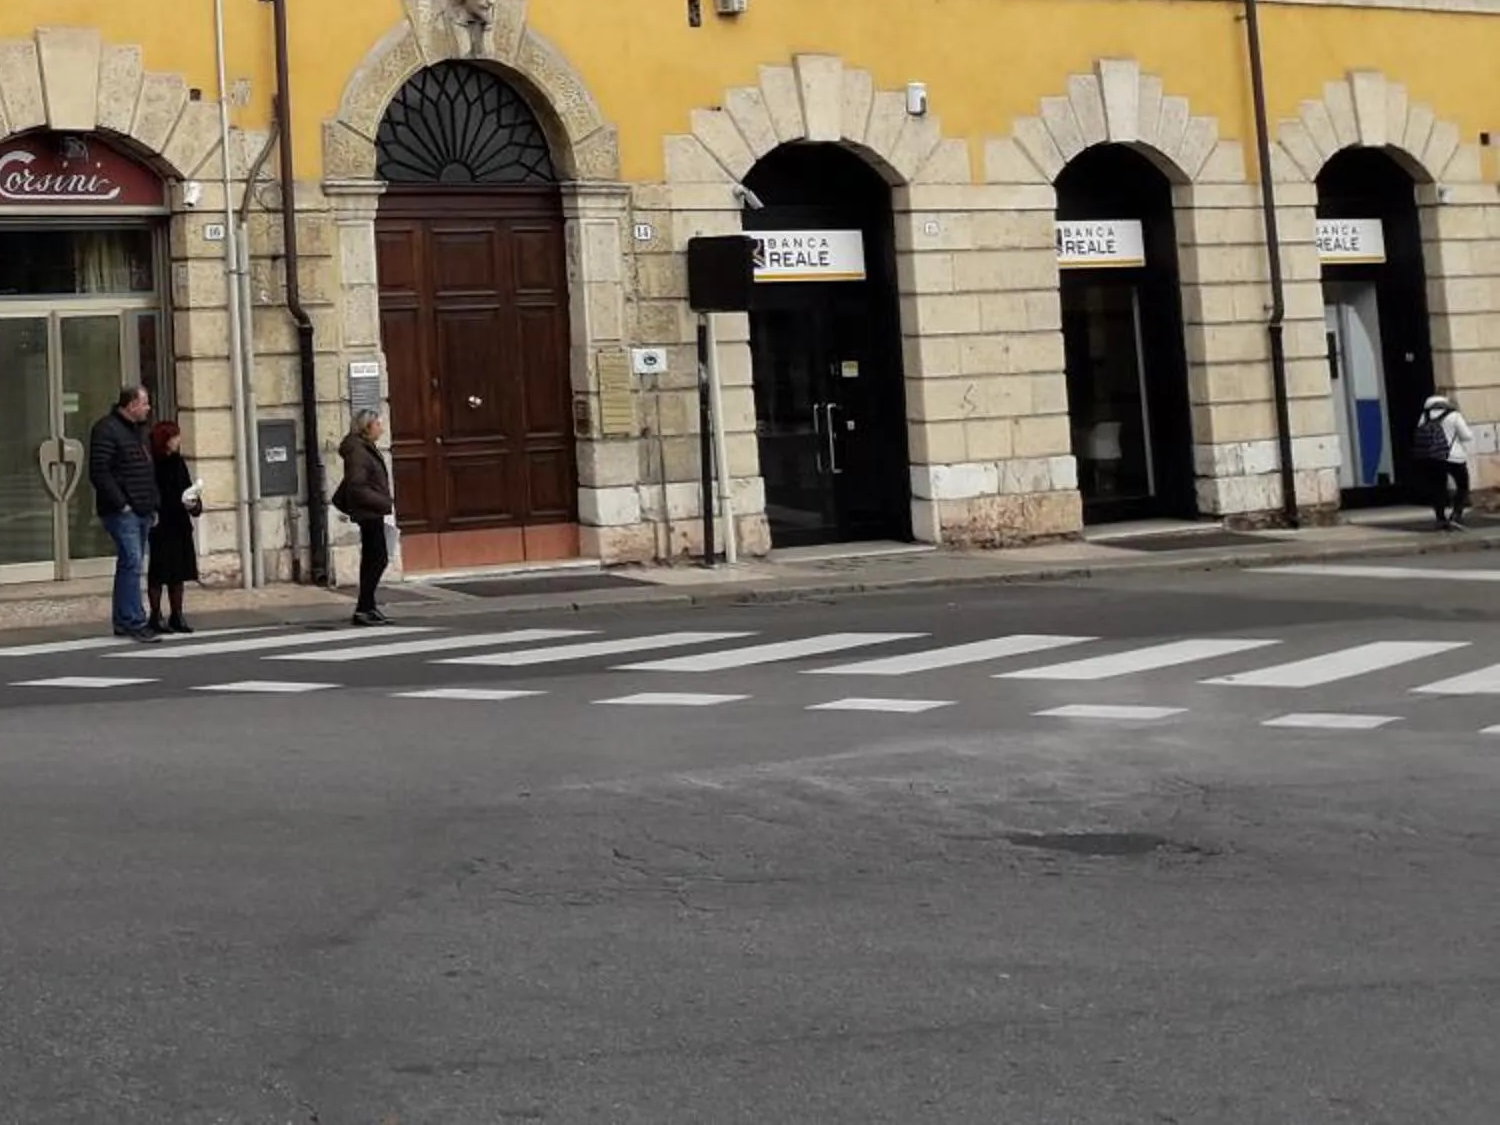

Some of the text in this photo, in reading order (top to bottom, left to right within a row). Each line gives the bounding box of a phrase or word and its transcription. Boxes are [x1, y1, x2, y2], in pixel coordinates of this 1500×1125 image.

[1063, 227, 1115, 237] BANCA
[767, 237, 830, 249] BANCA
[1064, 240, 1117, 255] REALE
[768, 250, 831, 268] REALE
